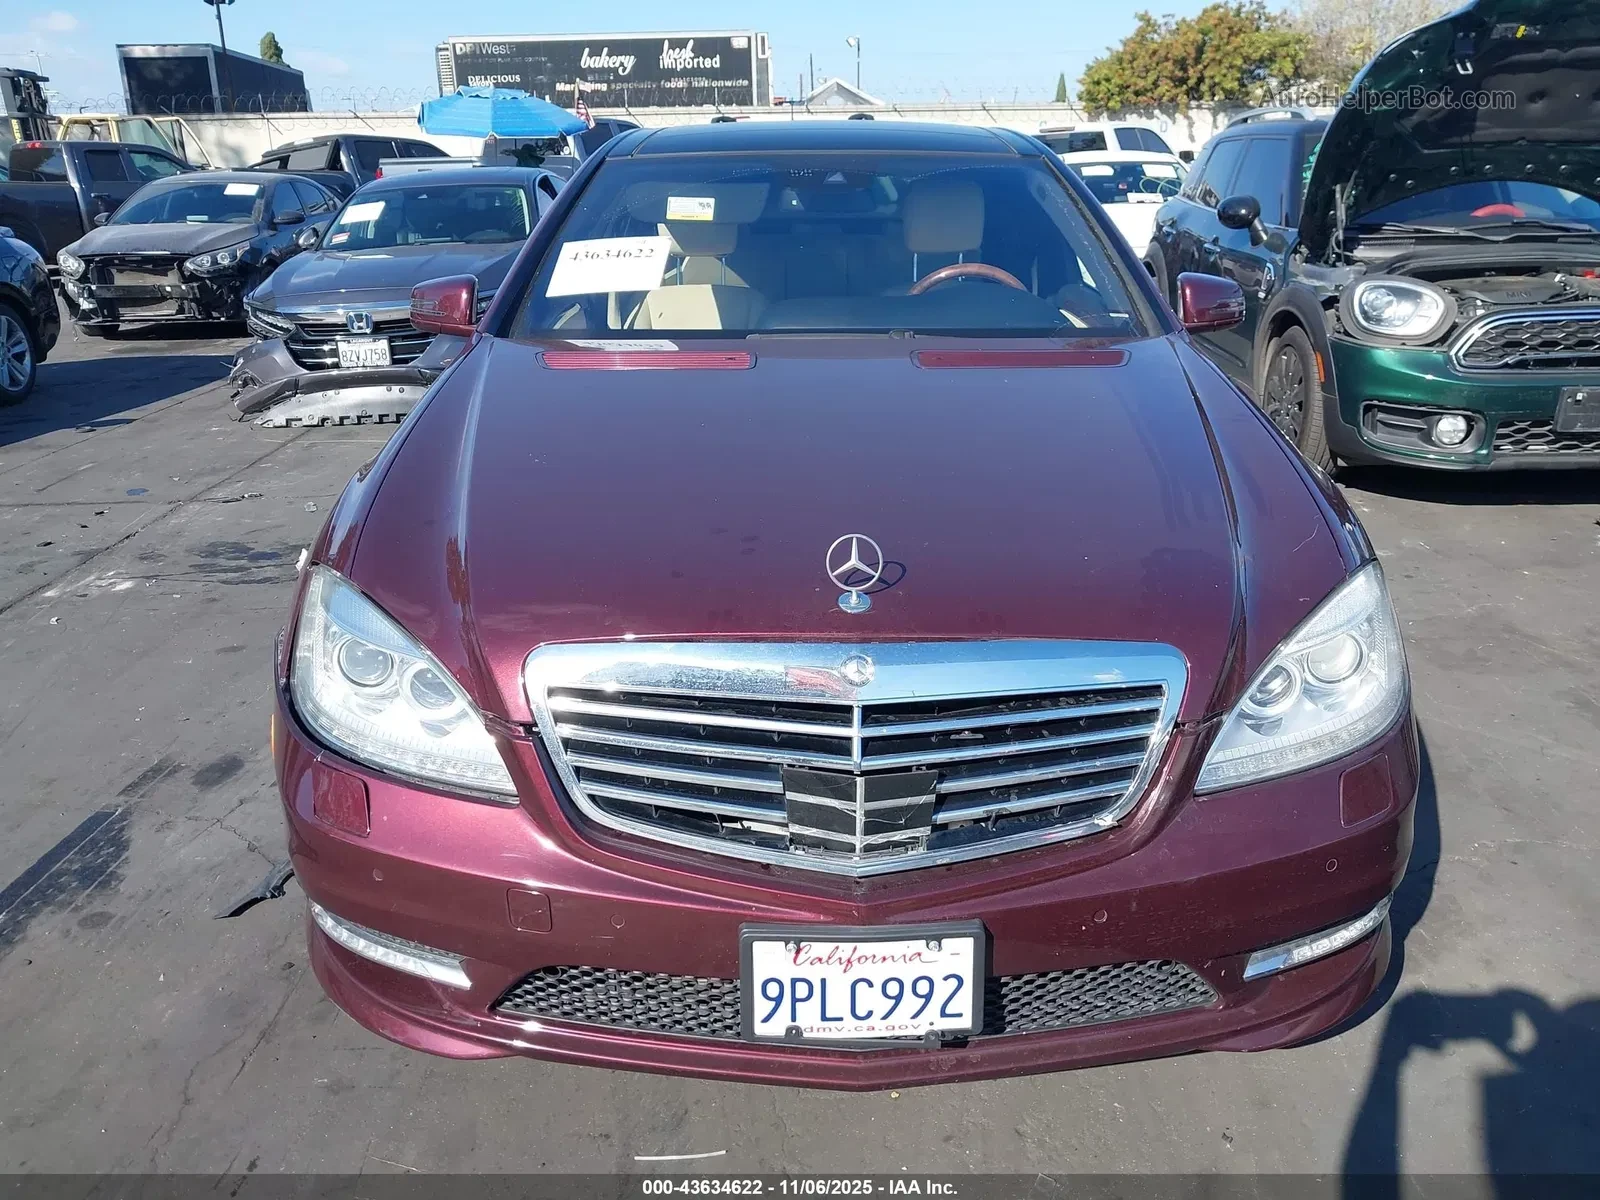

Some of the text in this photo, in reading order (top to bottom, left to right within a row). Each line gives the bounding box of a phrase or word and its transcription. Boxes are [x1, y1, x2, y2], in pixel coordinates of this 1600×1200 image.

[580, 47, 637, 75] bakery
[659, 54, 720, 71] imported
[468, 74, 521, 83] DELICIOUS
[556, 82, 608, 91] Maring
[692, 79, 749, 88] nationwide
[341, 348, 388, 363] 8ZVJ758
[792, 943, 938, 973] California
[760, 973, 965, 1024] 9PLC992
[803, 1023, 922, 1034] dmv.ca.gov
